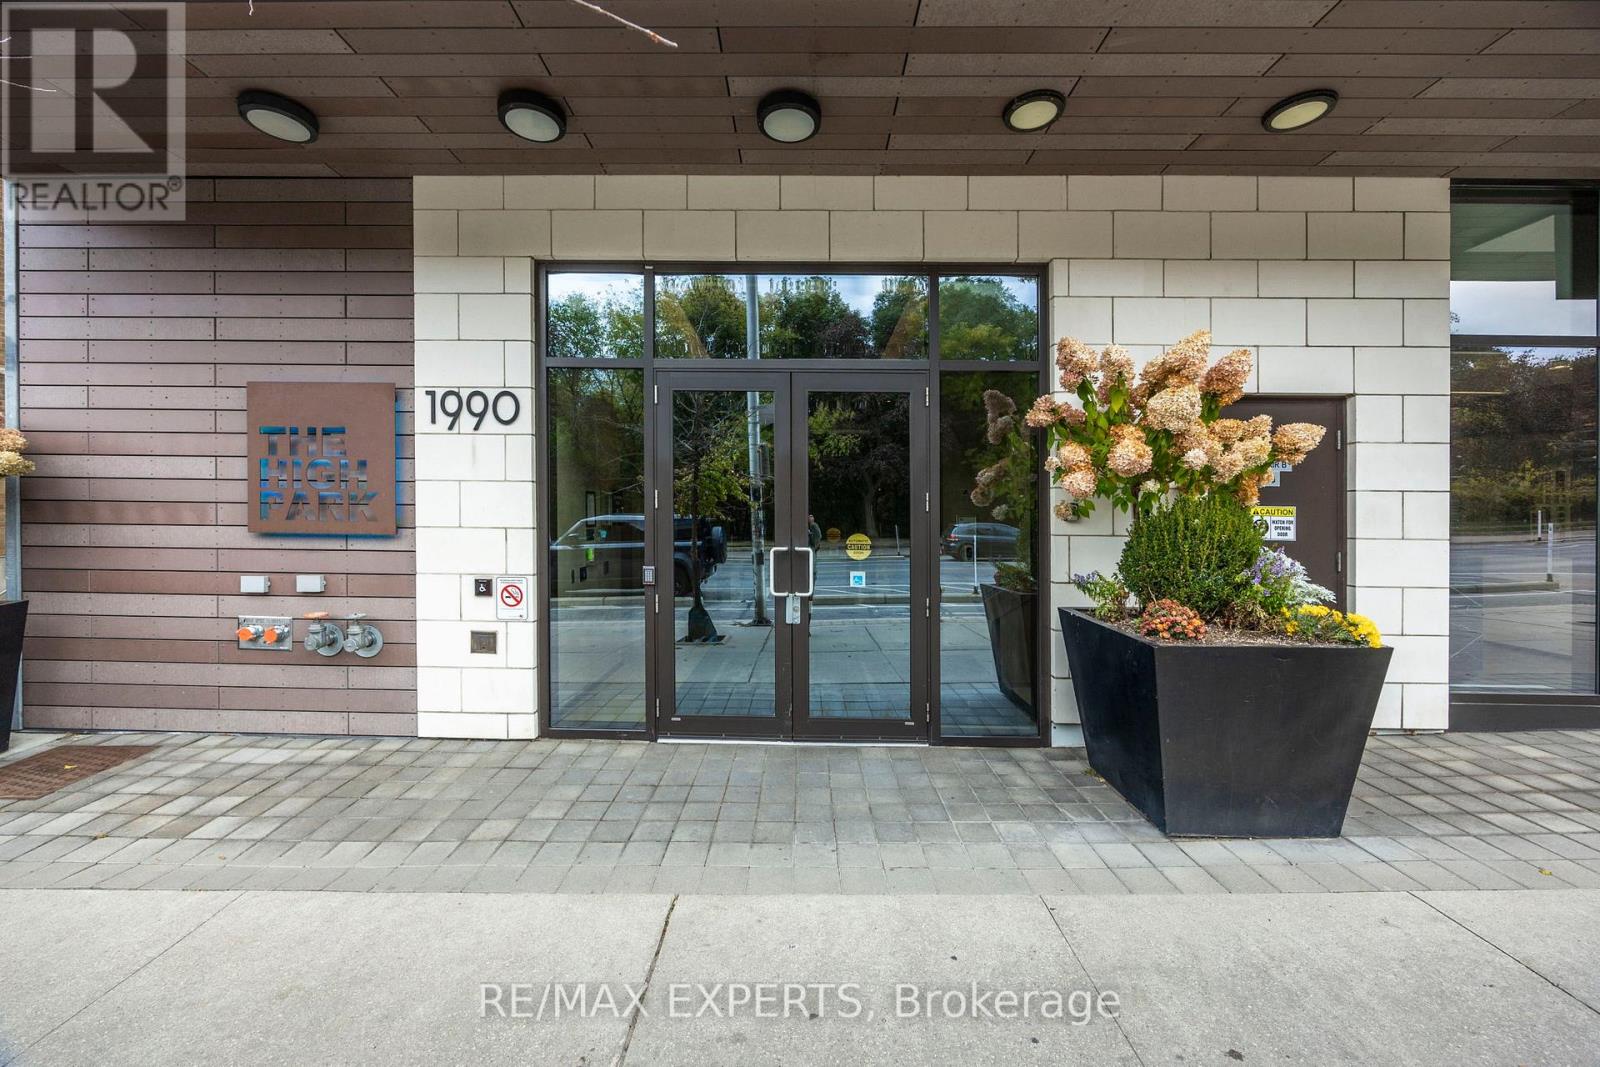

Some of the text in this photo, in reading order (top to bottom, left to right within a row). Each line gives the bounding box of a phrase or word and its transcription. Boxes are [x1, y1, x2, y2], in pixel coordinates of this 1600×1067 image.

[425, 390, 520, 431] 1990
[259, 426, 346, 457] THE
[260, 458, 368, 490] HIGH
[259, 491, 379, 522] PARK
